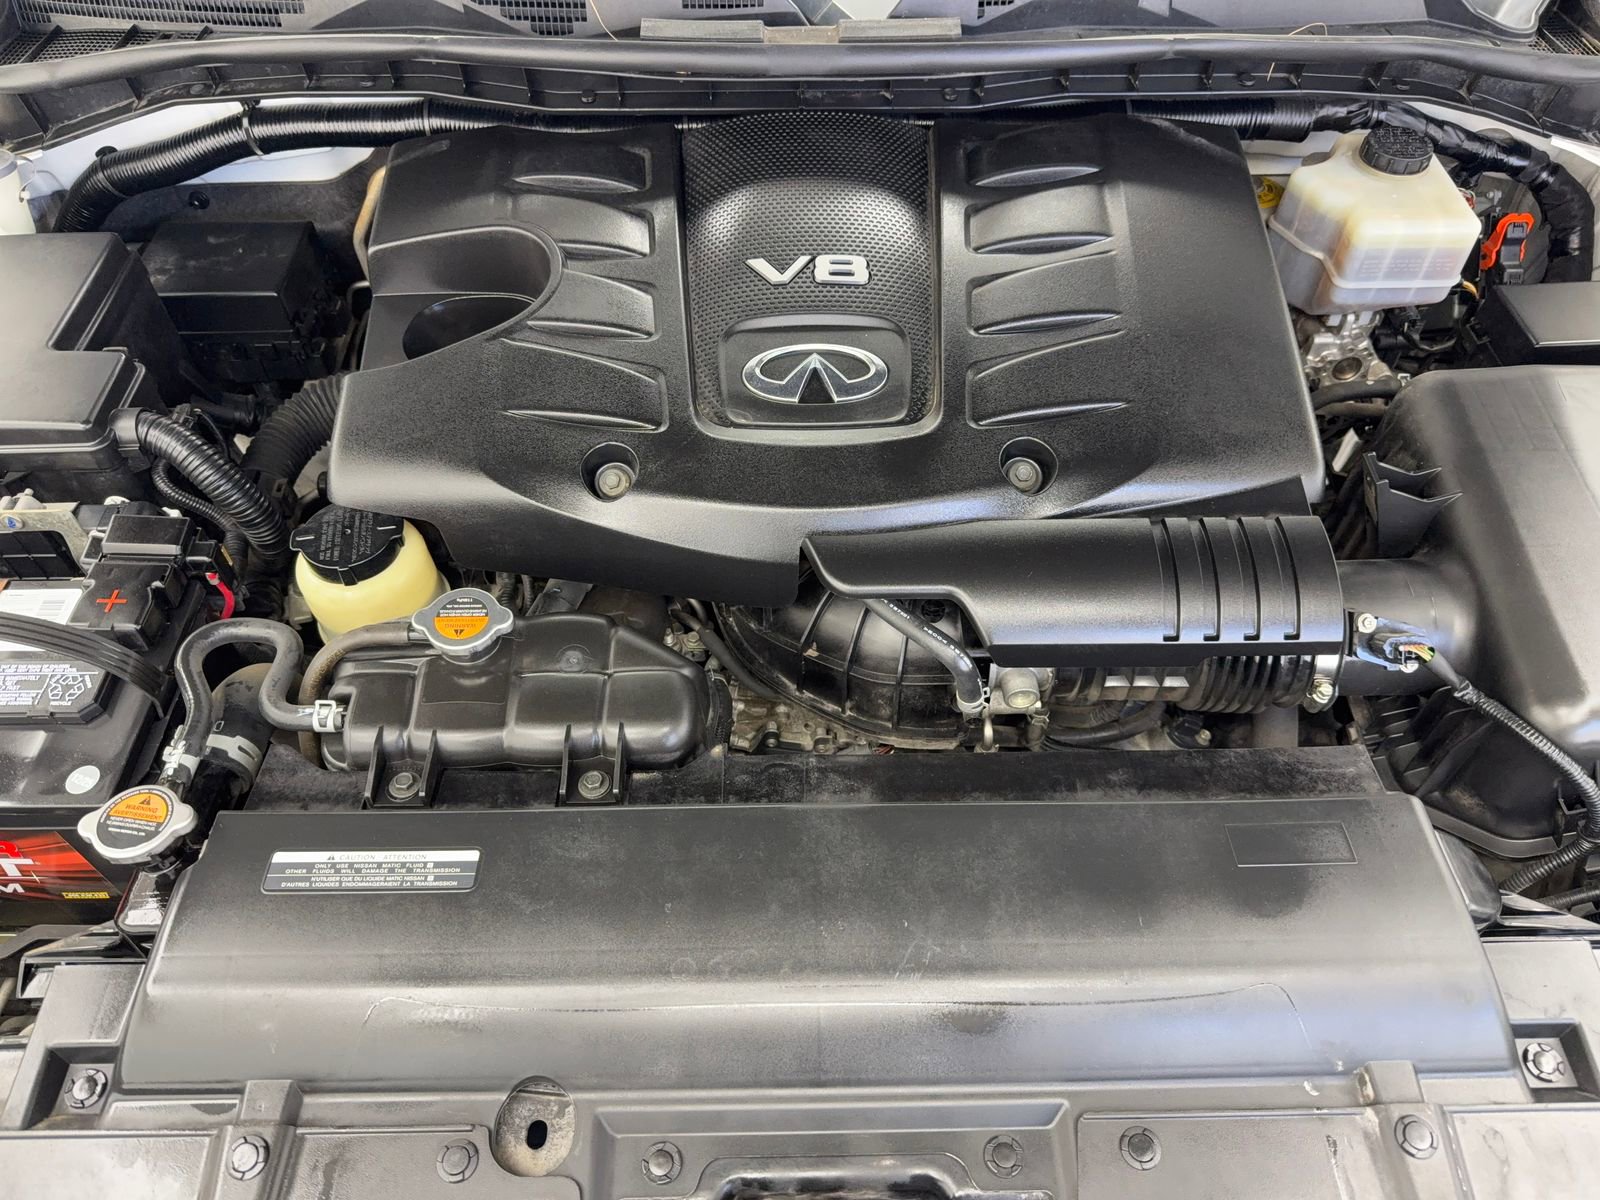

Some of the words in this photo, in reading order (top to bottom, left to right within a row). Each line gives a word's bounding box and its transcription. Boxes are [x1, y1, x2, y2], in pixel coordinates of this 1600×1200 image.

[744, 254, 871, 286] V8
[125, 804, 158, 813] WARNING
[112, 810, 162, 820] AVERTISSEMENT
